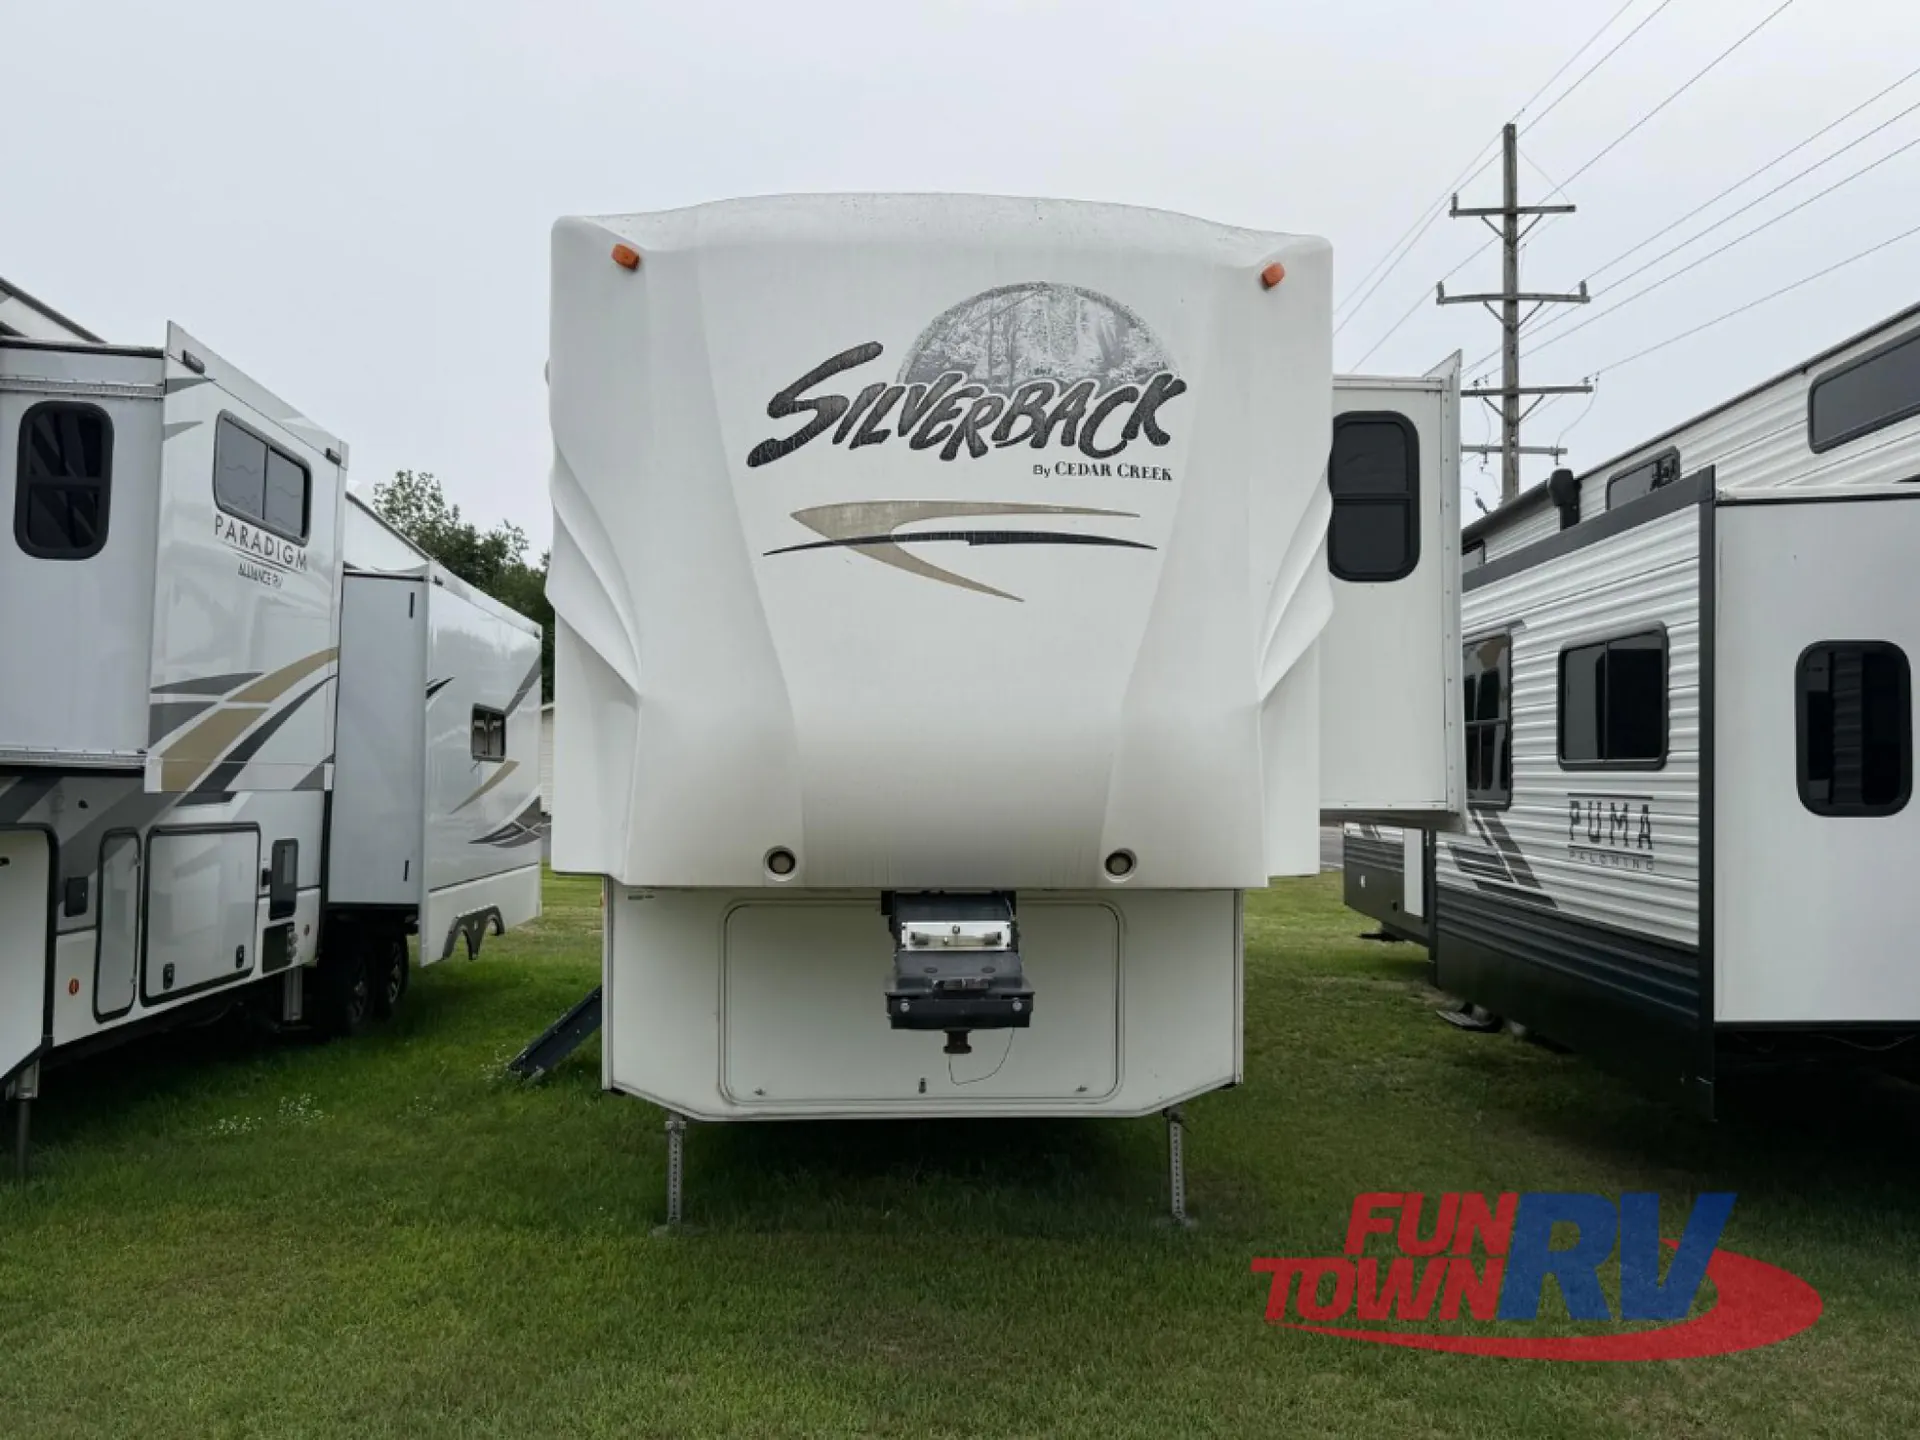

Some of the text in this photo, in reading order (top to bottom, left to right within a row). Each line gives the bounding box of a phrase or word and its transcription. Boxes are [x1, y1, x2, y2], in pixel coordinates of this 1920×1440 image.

[746, 341, 1187, 468] SILVERBACK
[1033, 461, 1172, 481] By CEDAR CREEK
[215, 513, 308, 572] PARADIGM
[1569, 801, 1653, 850] PUMA
